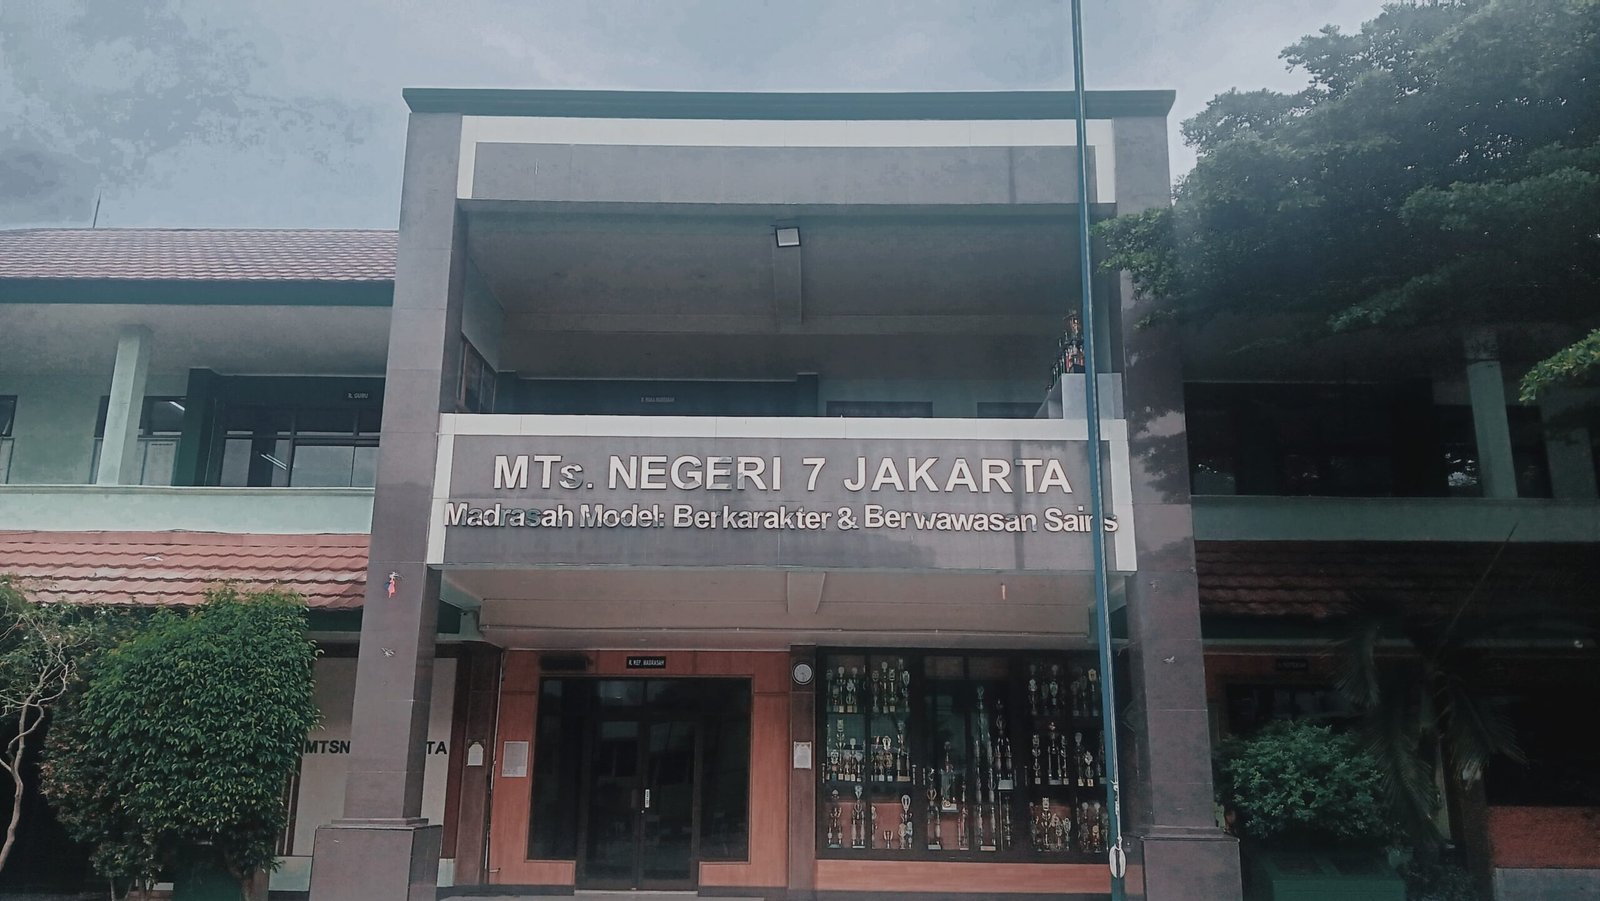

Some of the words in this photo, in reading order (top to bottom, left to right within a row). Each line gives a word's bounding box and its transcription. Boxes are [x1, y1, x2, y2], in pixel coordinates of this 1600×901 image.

[493, 454, 595, 490] MTs.
[607, 454, 782, 491] NEGERI
[801, 456, 827, 492] 7
[843, 456, 1074, 494] JAKARTA
[443, 502, 574, 528] Madrasah
[672, 503, 833, 530] Berkarakter
[836, 504, 860, 531] &
[863, 504, 1038, 532] Berwawasan
[303, 740, 351, 754] MTSN
